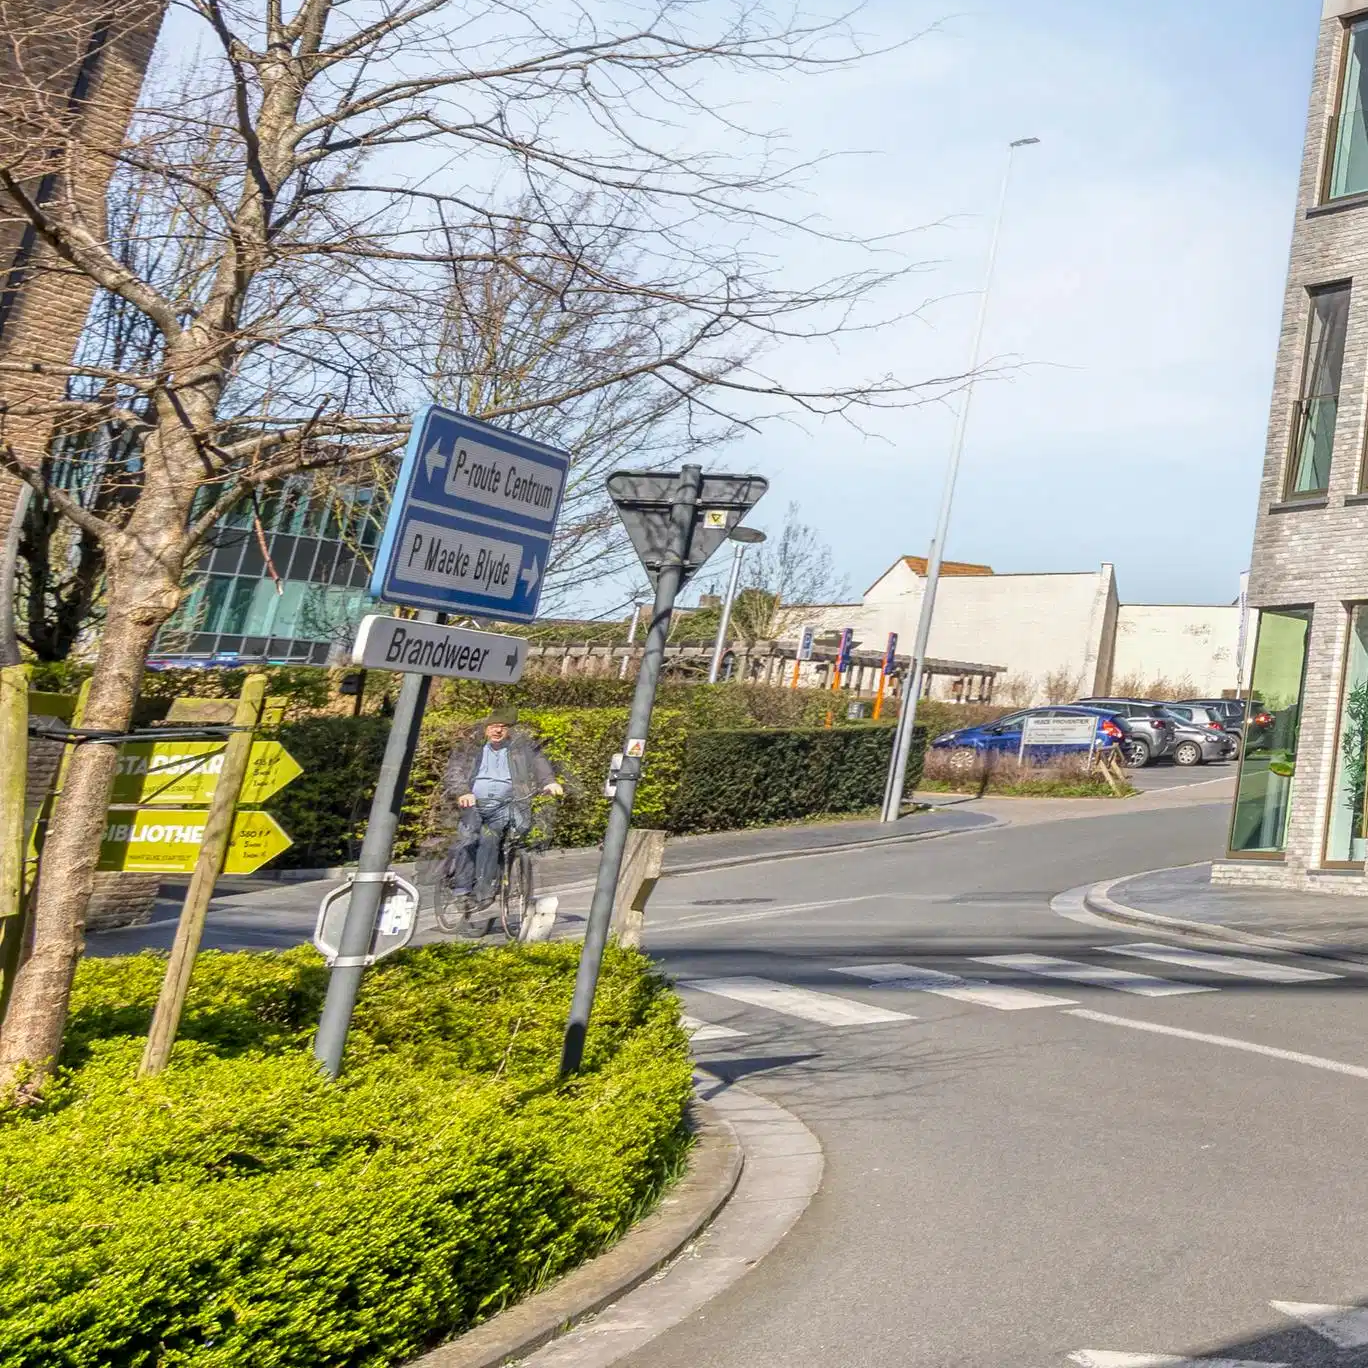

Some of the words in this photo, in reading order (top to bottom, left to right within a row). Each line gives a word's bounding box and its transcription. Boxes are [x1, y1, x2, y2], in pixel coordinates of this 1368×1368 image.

[453, 450, 501, 493] P-route
[504, 466, 553, 509] Centrum
[408, 534, 423, 568] P
[424, 537, 470, 578] Maeke
[473, 549, 511, 591] Blyde
[385, 627, 490, 673] Brandweer
[114, 753, 225, 775] STADSPAR
